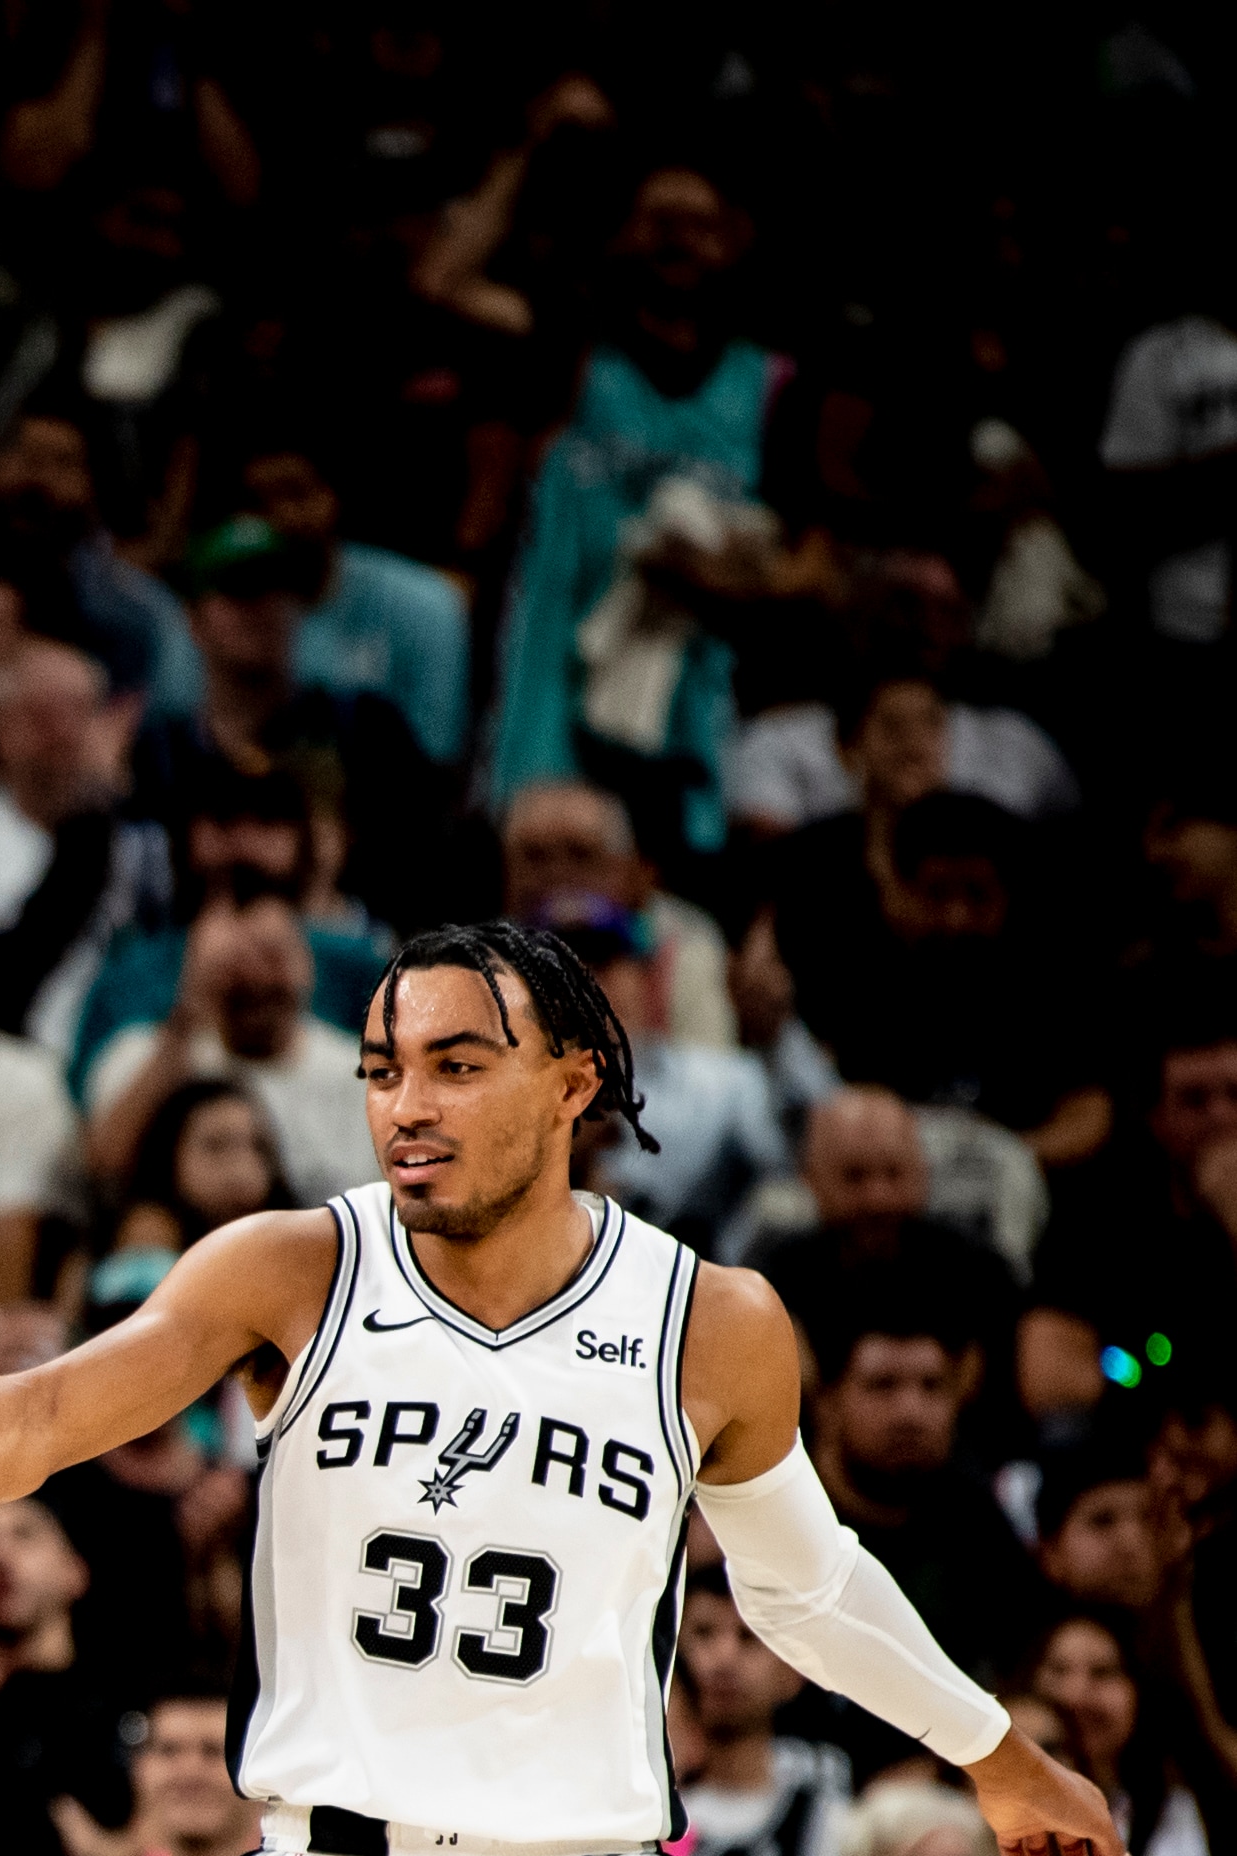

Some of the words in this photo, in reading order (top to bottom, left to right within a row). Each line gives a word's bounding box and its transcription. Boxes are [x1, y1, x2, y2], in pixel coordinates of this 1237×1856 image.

[576, 1330, 646, 1369] Self.
[317, 1401, 654, 1522] SPURS
[350, 1526, 562, 1688] 33
